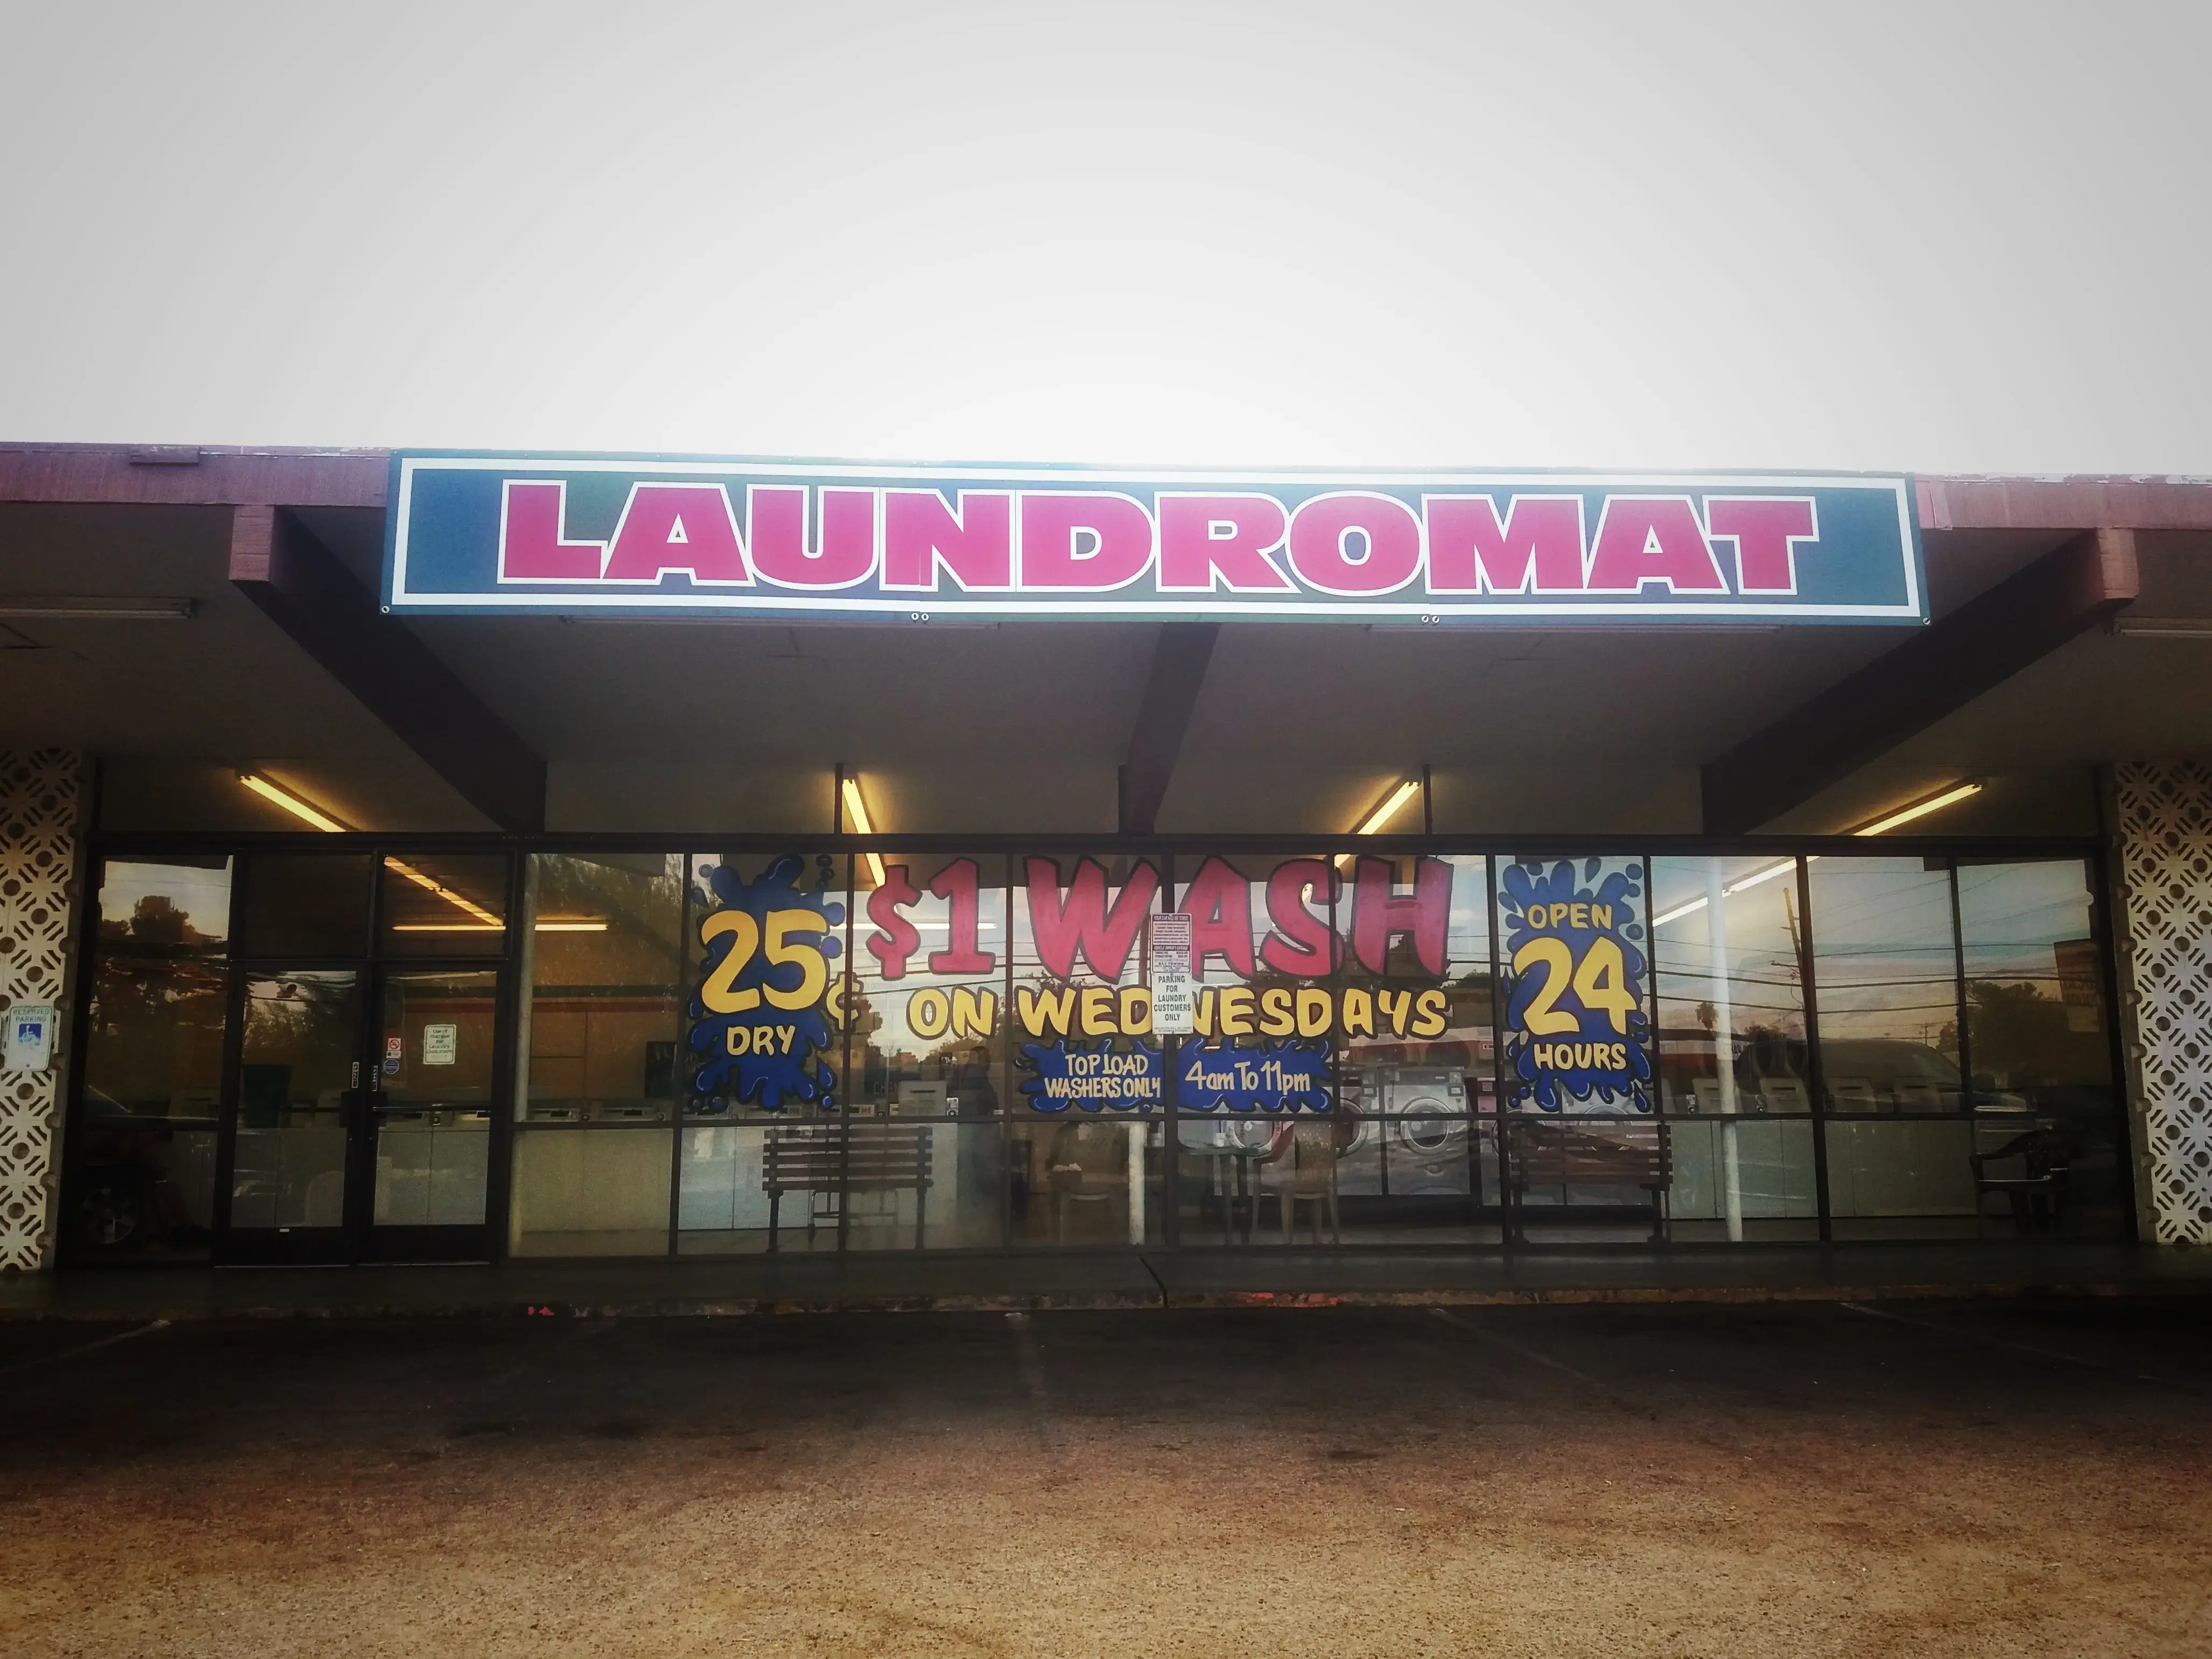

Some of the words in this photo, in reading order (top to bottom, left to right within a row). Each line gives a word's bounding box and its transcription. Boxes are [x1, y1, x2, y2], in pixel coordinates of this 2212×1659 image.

[497, 478, 1819, 596] LAUNDROMAT
[866, 858, 996, 981] $1
[1023, 853, 1454, 985] WASH
[1528, 902, 1613, 930] OPEN
[1514, 936, 1637, 1035] 24
[906, 986, 998, 1039] ON
[726, 1025, 795, 1056] DRY
[1065, 1054, 1101, 1076] TOP
[1104, 1055, 1148, 1076] LOAD
[1533, 1043, 1626, 1071] HOURS
[1044, 1078, 1121, 1098] WASHERS
[1123, 1079, 1161, 1099] ONLY
[1184, 1061, 1235, 1091] 4am
[1234, 1061, 1259, 1090] To
[1261, 1061, 1310, 1095] 11pm
